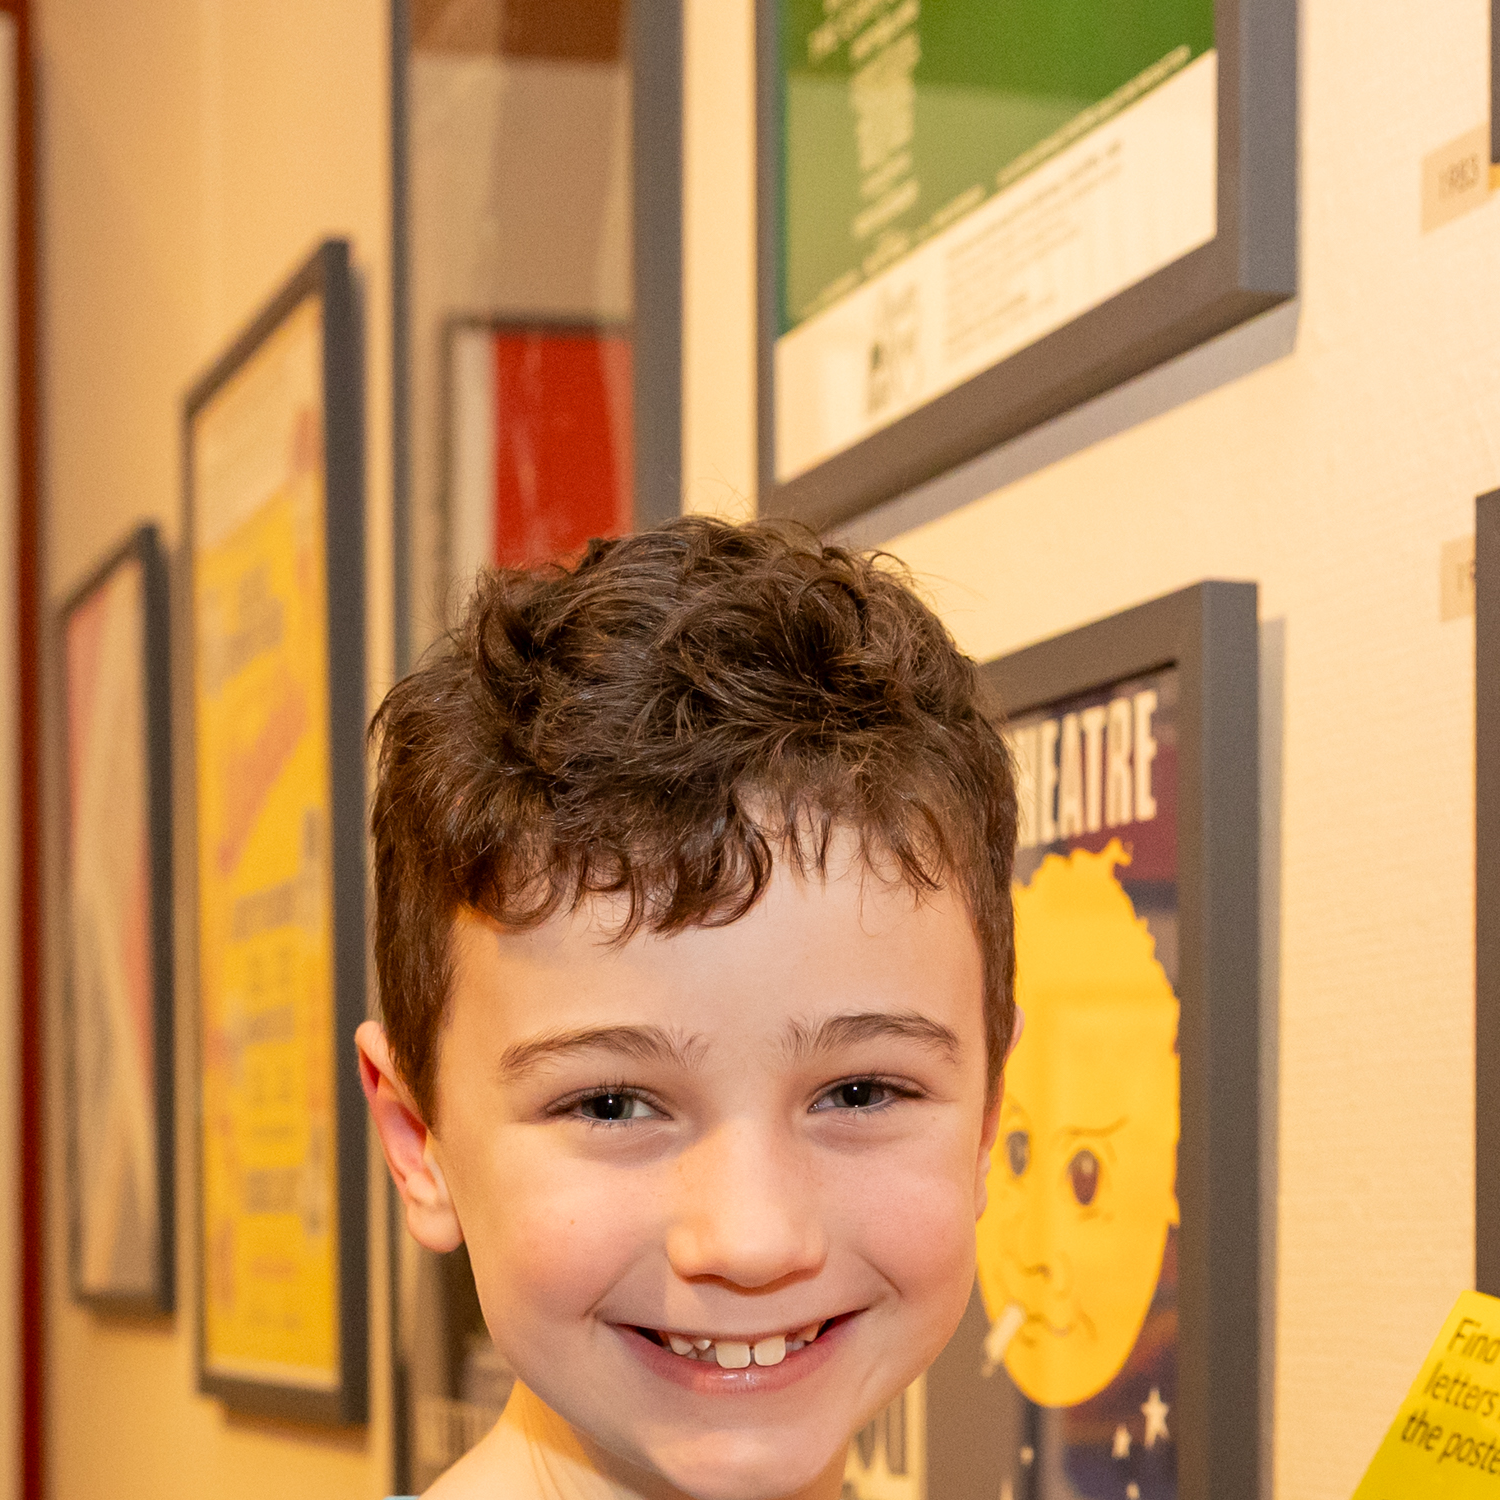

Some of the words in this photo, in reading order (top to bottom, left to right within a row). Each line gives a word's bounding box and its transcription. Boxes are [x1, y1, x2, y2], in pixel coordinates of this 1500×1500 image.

[1013, 690, 1157, 848] HEATRE
[1423, 1362, 1499, 1417] letters
[1401, 1408, 1443, 1452] the
